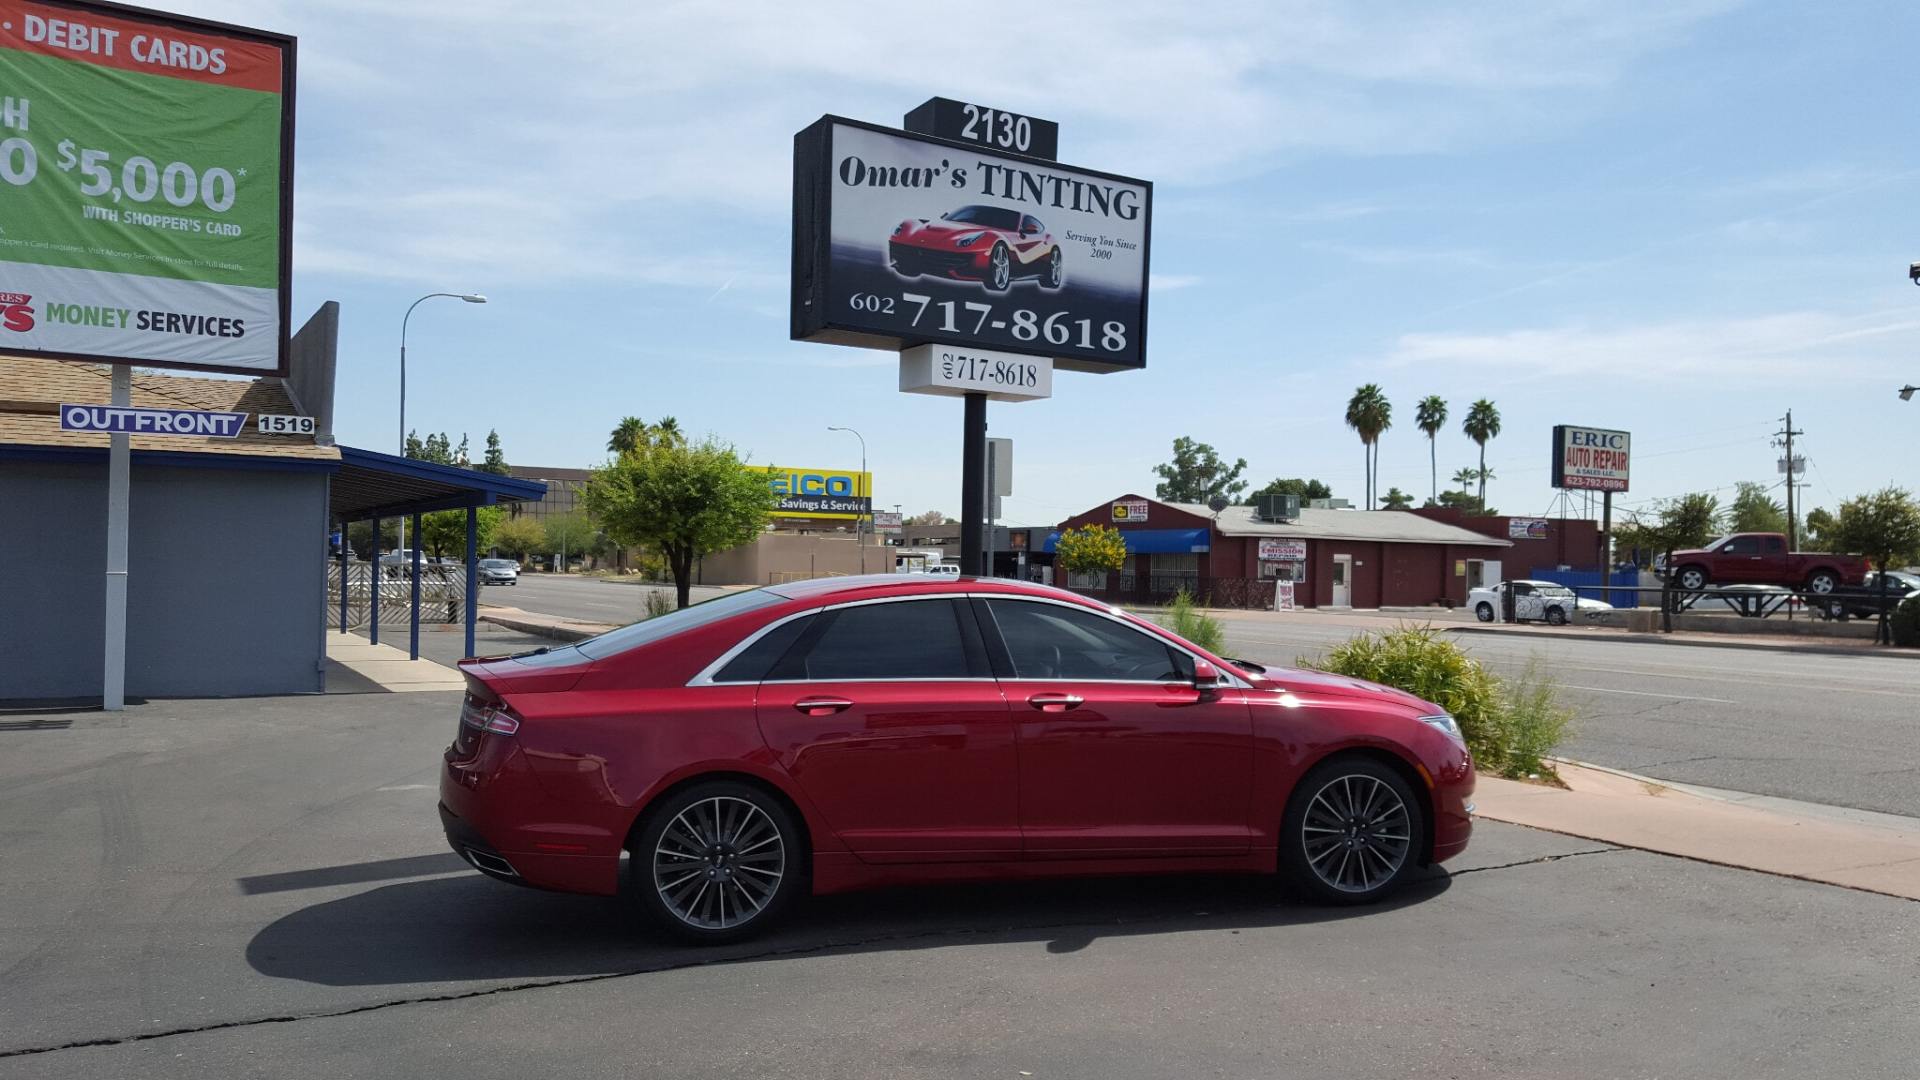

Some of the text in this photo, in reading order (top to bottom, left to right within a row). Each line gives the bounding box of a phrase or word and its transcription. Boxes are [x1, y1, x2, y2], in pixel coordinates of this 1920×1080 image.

[24, 14, 227, 75] DEBIT CARDS
[0, 96, 30, 132] H
[961, 103, 1032, 152] 2130
[839, 156, 1141, 221] Omar's TINTING
[83, 205, 242, 237] WITH SHOPPER'S CARD
[1065, 229, 1137, 250] Serving You Since
[1089, 248, 1113, 261] 2000
[46, 302, 131, 329] MONEY
[136, 310, 245, 338] SERVICES
[849, 292, 1127, 352] 602 717-8618
[942, 352, 1037, 387] 602 717-8618
[67, 407, 237, 435] OUTFRONT
[259, 416, 313, 432] 1519
[1571, 431, 1623, 449] ERIC
[1566, 447, 1627, 471] AUTO REPAIR
[769, 474, 852, 496] EICO
[781, 498, 819, 511] Savings
[821, 500, 829, 510] &
[830, 501, 865, 511] Service
[1130, 505, 1147, 513] FREE
